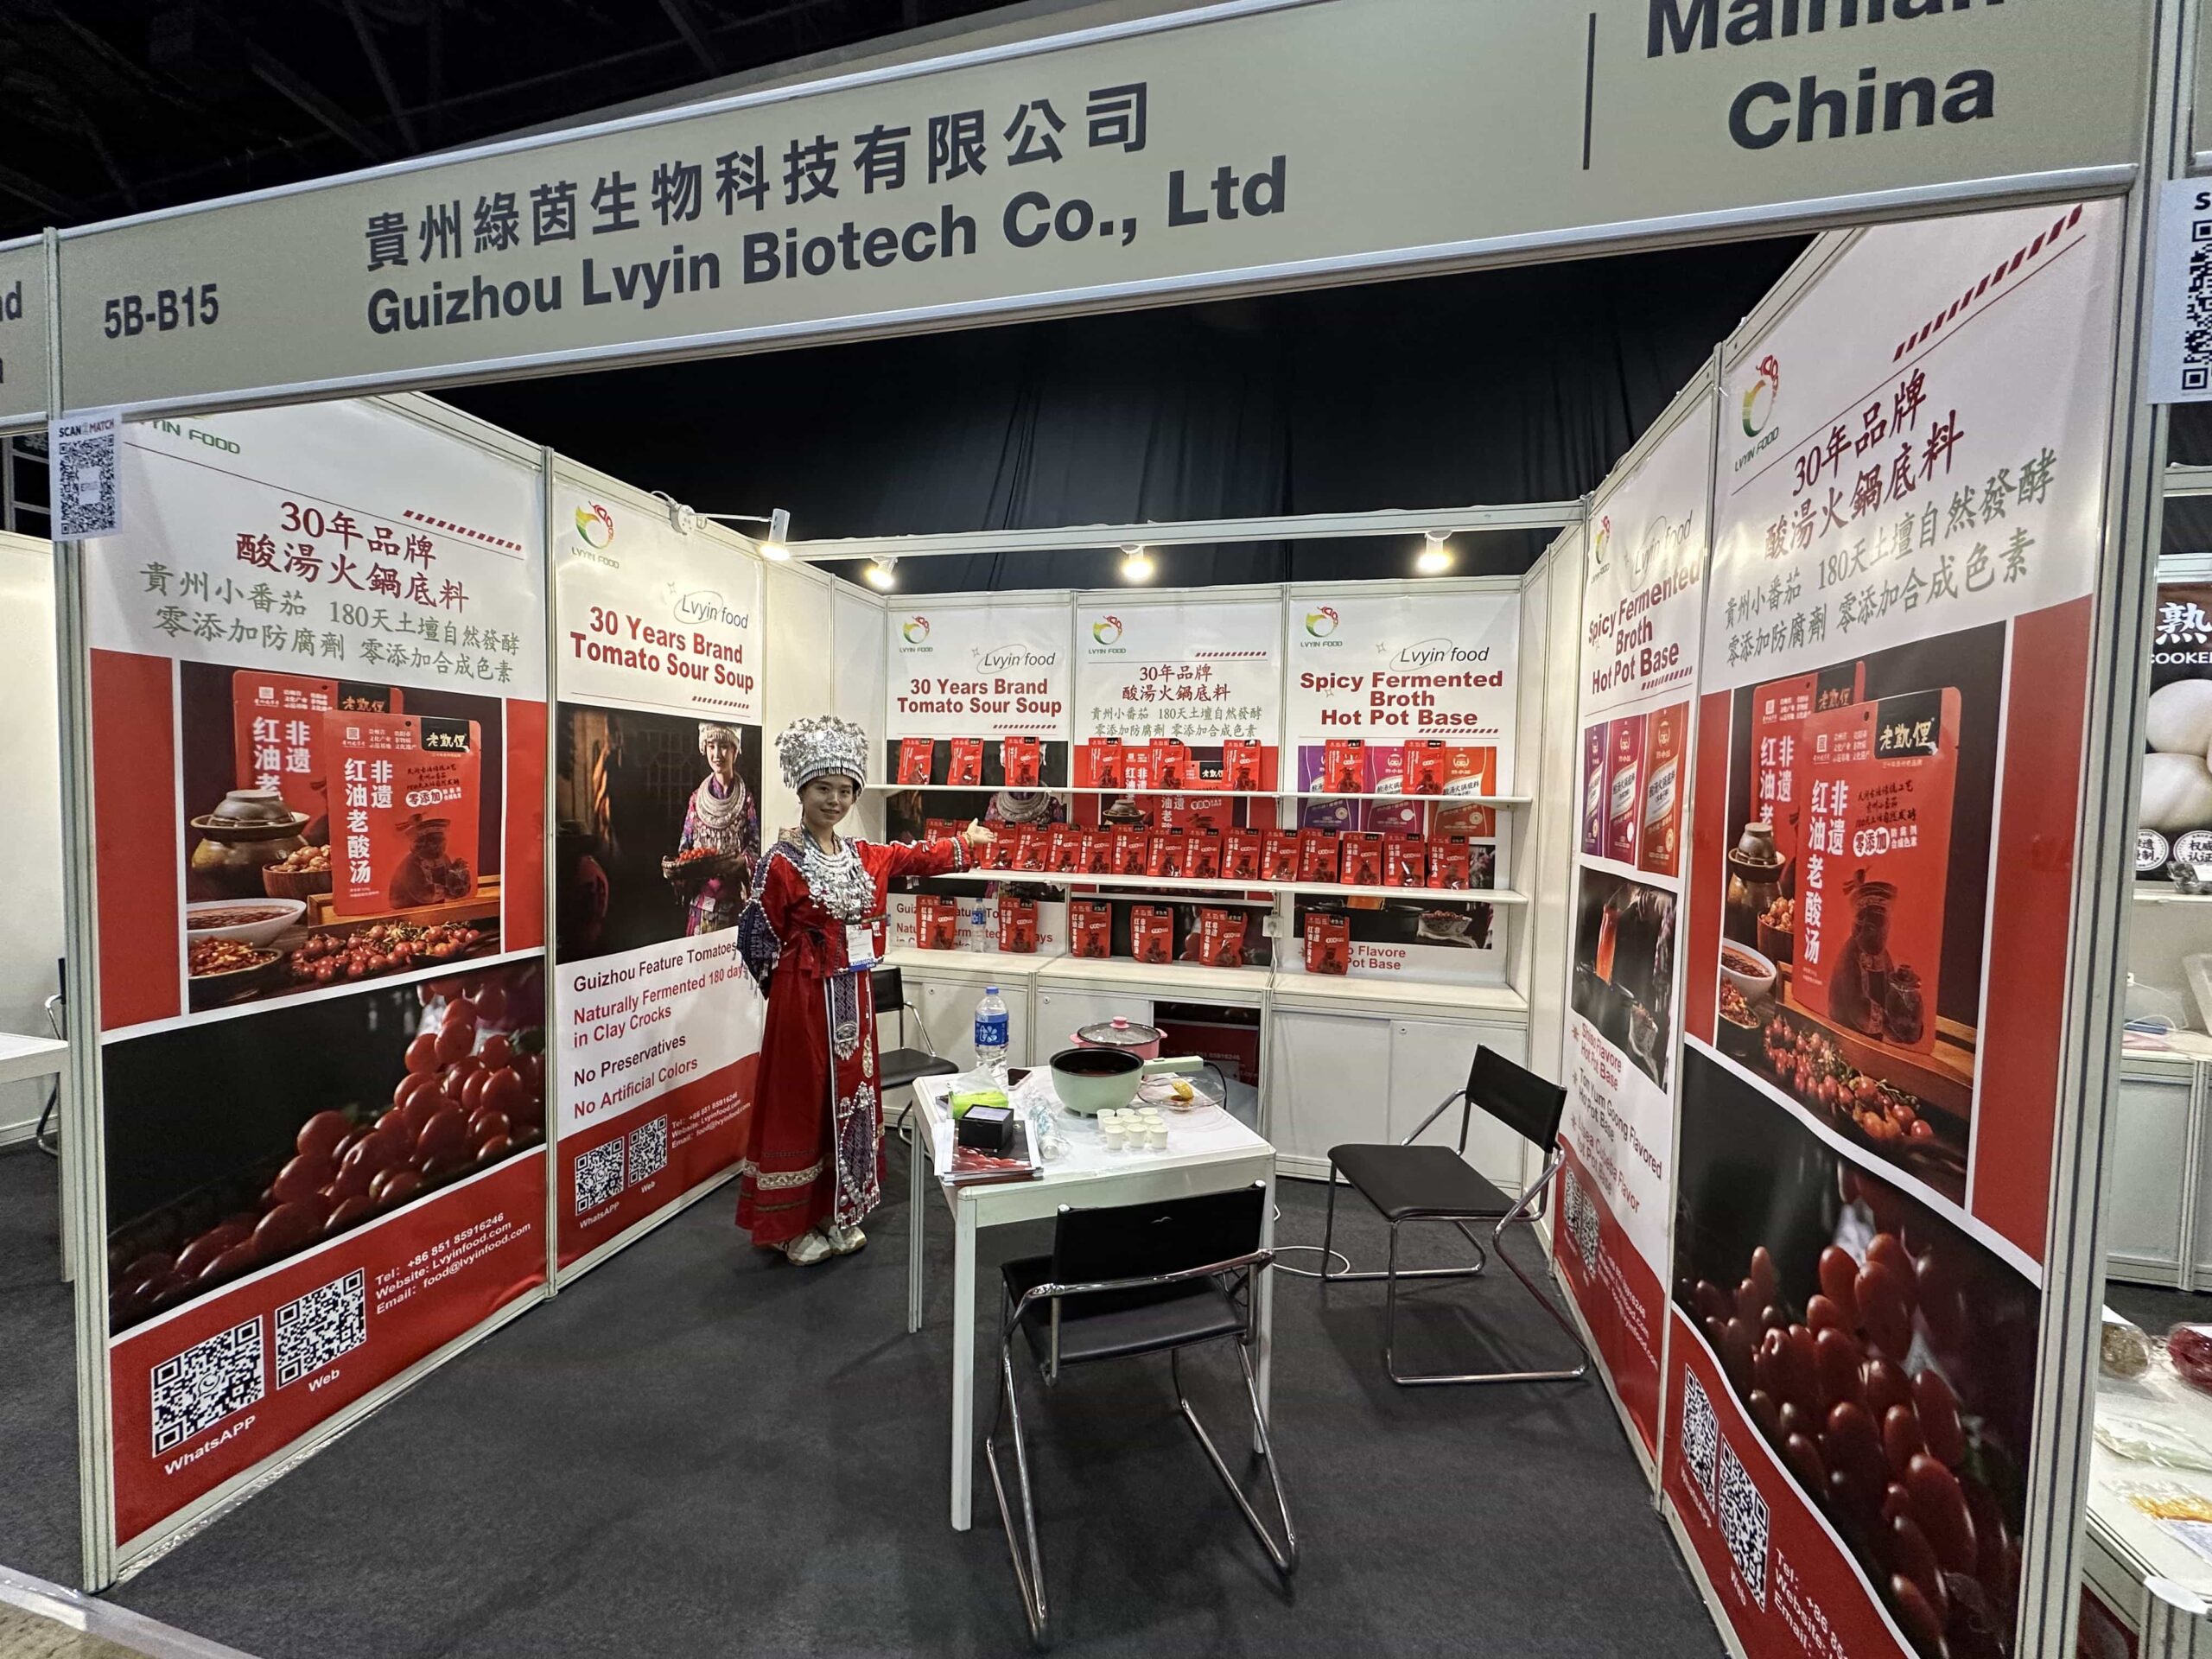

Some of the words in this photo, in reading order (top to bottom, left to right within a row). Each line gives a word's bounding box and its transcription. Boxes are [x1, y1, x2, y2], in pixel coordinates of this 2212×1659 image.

[1728, 67, 1995, 150] China
[365, 82, 1148, 272] 貴州綠茵生物科技有限公司
[367, 271, 563, 334] Guizhou
[582, 245, 721, 309] Lvyin
[743, 205, 976, 284] Biotech
[1002, 191, 1138, 247] Co.,
[1168, 156, 1287, 227] Ltd
[105, 283, 219, 340] 5B-B15
[188, 429, 241, 454] FOOD
[1734, 447, 1755, 473] LVYIN
[1755, 427, 1780, 454] FOOD
[1793, 368, 1926, 496] 30年品牌
[1764, 409, 1965, 561] 酸湯火鍋底料
[281, 501, 436, 567] 30年品牌
[140, 561, 307, 617] 貴州小番茄
[236, 532, 469, 613] 酸湯火鍋底料
[1836, 527, 2036, 634] 零添加合成色素
[681, 594, 718, 621] Lvyin
[721, 607, 749, 629] food
[1588, 611, 1617, 646] Spicy
[1618, 557, 1700, 626] Fermented
[153, 604, 346, 662] 零添加防腐劑
[360, 637, 514, 683] 零添加合成色素
[589, 606, 618, 635] 30
[626, 614, 686, 651] Years
[693, 632, 743, 664] Brand
[984, 652, 1020, 669] Lvyin
[1024, 652, 1056, 666] food
[1400, 648, 1445, 666] Lvyin
[1450, 646, 1490, 662] food
[1616, 616, 1653, 657] Broth
[570, 631, 660, 672] Tomato
[666, 652, 709, 683] Sour
[714, 664, 754, 695] Soup
[910, 678, 931, 695] 30
[937, 678, 988, 695] Years
[995, 678, 1048, 695] Brand
[1139, 663, 1213, 682] 30年品牌
[1300, 672, 1364, 692] Spicy
[1372, 671, 1503, 688] Fermented
[1592, 667, 1612, 695] Hot
[1614, 654, 1636, 687] Pot
[1640, 642, 1680, 677] Base
[897, 696, 963, 713] Tomato
[969, 696, 1010, 713] Sour
[1016, 696, 1062, 717] Soup
[1122, 683, 1230, 702] 酸湯火鍋底料
[1321, 709, 1362, 726] Hot
[1370, 709, 1409, 726] Pot
[1418, 709, 1478, 726] Base
[1370, 690, 1435, 707] Broth
[371, 759, 394, 809] 非遗
[344, 757, 372, 885] 红油老酸汤
[1827, 779, 1849, 856] 非遗
[1804, 779, 1829, 964] 红油老酸汤
[574, 963, 635, 993] Guizhou
[639, 955, 683, 979] Feature
[687, 941, 737, 963] Tomatoes
[1358, 945, 1407, 958] Flavore
[1369, 957, 1402, 970] Base
[574, 994, 639, 1026] Naturally
[643, 974, 706, 1006] Fermented
[709, 969, 724, 986] 180
[574, 1032, 588, 1049] in
[594, 1020, 626, 1044] Clay
[630, 1005, 671, 1031] Crocks
[574, 1069, 596, 1087] No
[601, 1035, 687, 1077] Preservatives
[1597, 1038, 1622, 1073] Flavore
[1599, 1062, 1618, 1091] Base
[574, 1102, 596, 1119] No
[601, 1072, 655, 1110] Artificial
[658, 1057, 698, 1084] Colors
[1591, 1083, 1606, 1109] Yum
[1630, 1124, 1662, 1180] Flavored
[640, 1180, 656, 1194] Web
[1618, 1169, 1640, 1213] Flavor
[375, 1266, 400, 1286] Tel:
[407, 1251, 429, 1268] +86
[432, 1239, 450, 1256] 851
[454, 1212, 505, 1244] 85916246
[376, 1266, 429, 1300] Website:
[432, 1222, 512, 1270] Lvyinfood.com
[377, 1285, 416, 1314] Email:
[423, 1223, 531, 1288] food@lvyinfood.com
[308, 1367, 340, 1393] Web
[164, 1414, 257, 1475] WhatsAPP
[1730, 1566, 1747, 1607] Web
[1777, 1548, 1799, 1591] Tel:
[1774, 1589, 1812, 1657] Email:
[1775, 1567, 1827, 1657] Website:
